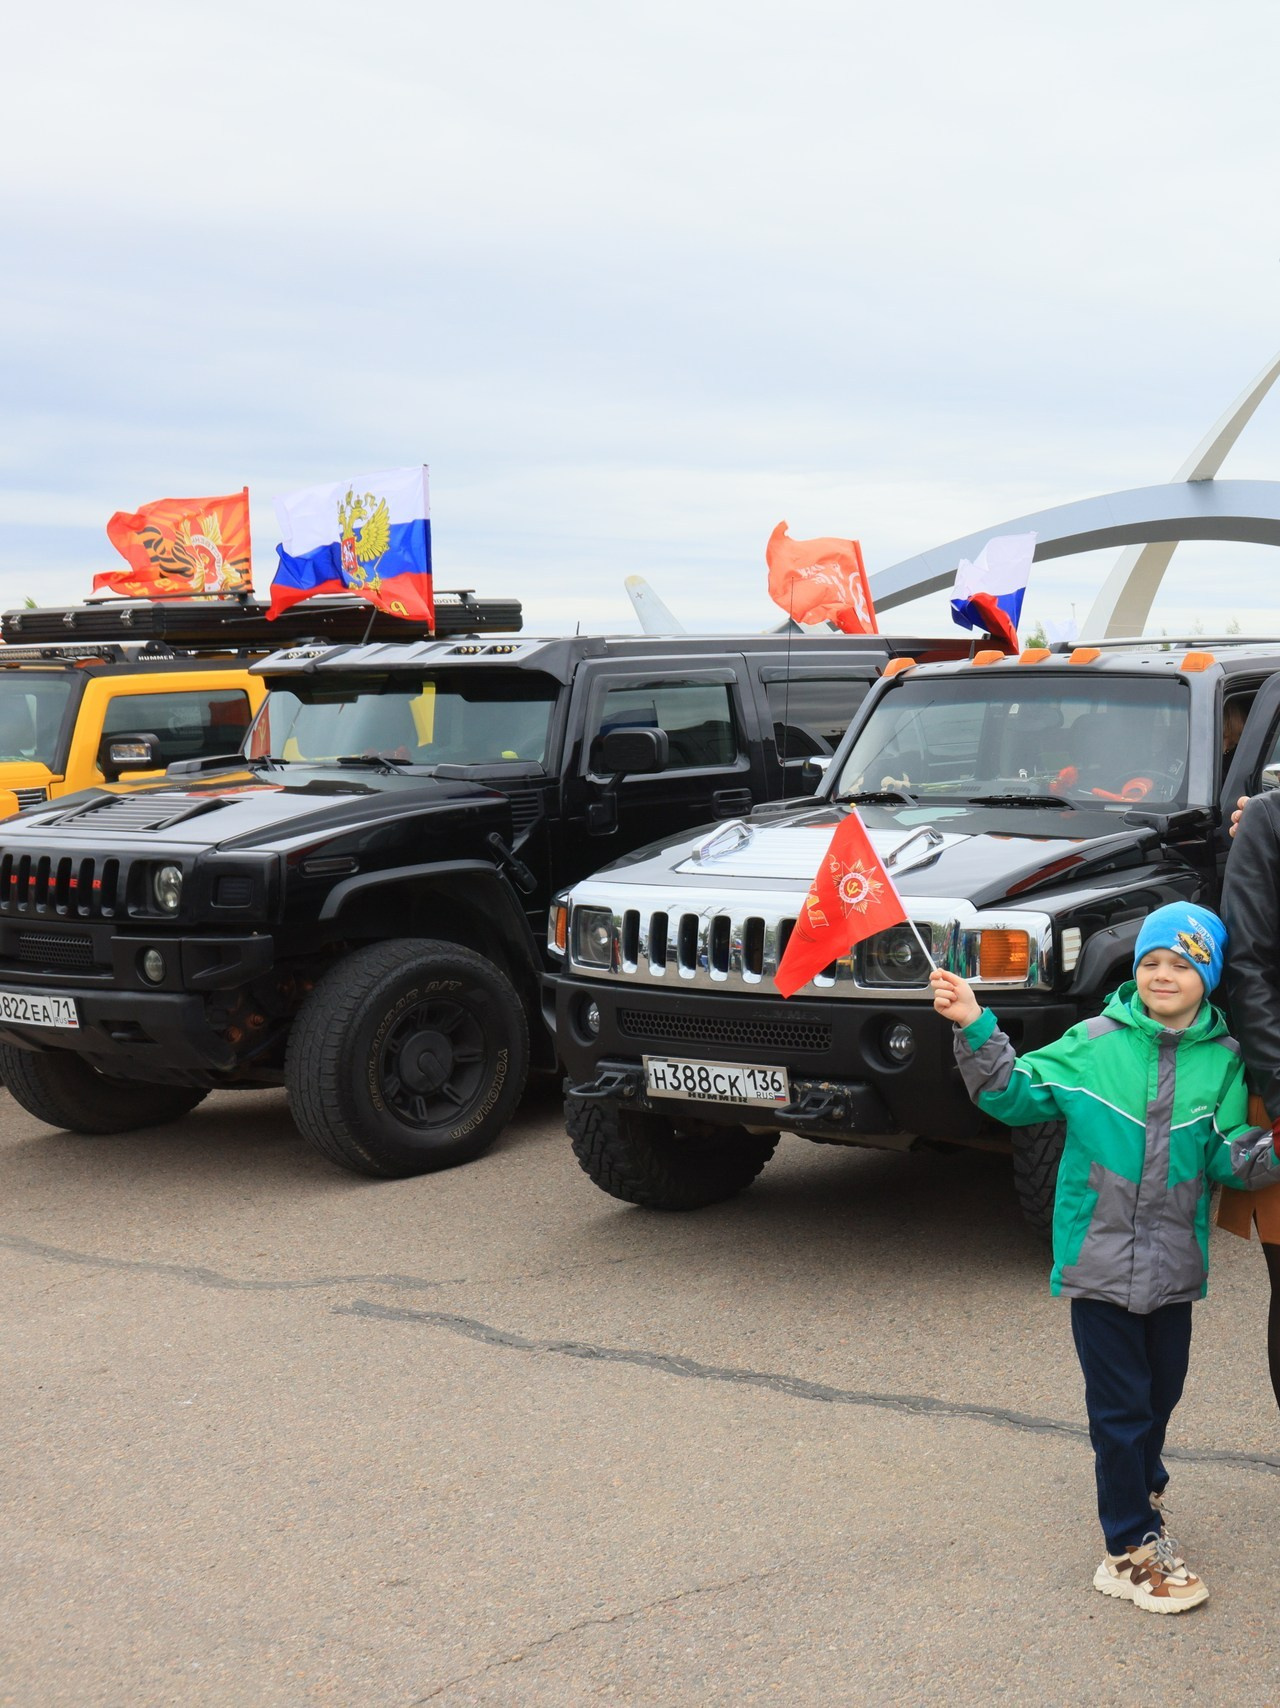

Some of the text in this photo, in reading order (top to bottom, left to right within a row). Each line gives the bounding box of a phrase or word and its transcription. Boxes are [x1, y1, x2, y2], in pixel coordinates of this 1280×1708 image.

[53, 1000, 71, 1018] 71
[368, 988, 419, 1111] GEOLANDAR
[747, 1070, 781, 1092] 136
[449, 1049, 508, 1139] YOKOHAMA
[688, 1091, 748, 1103] HUMMER
[756, 1091, 774, 1100] RUS
